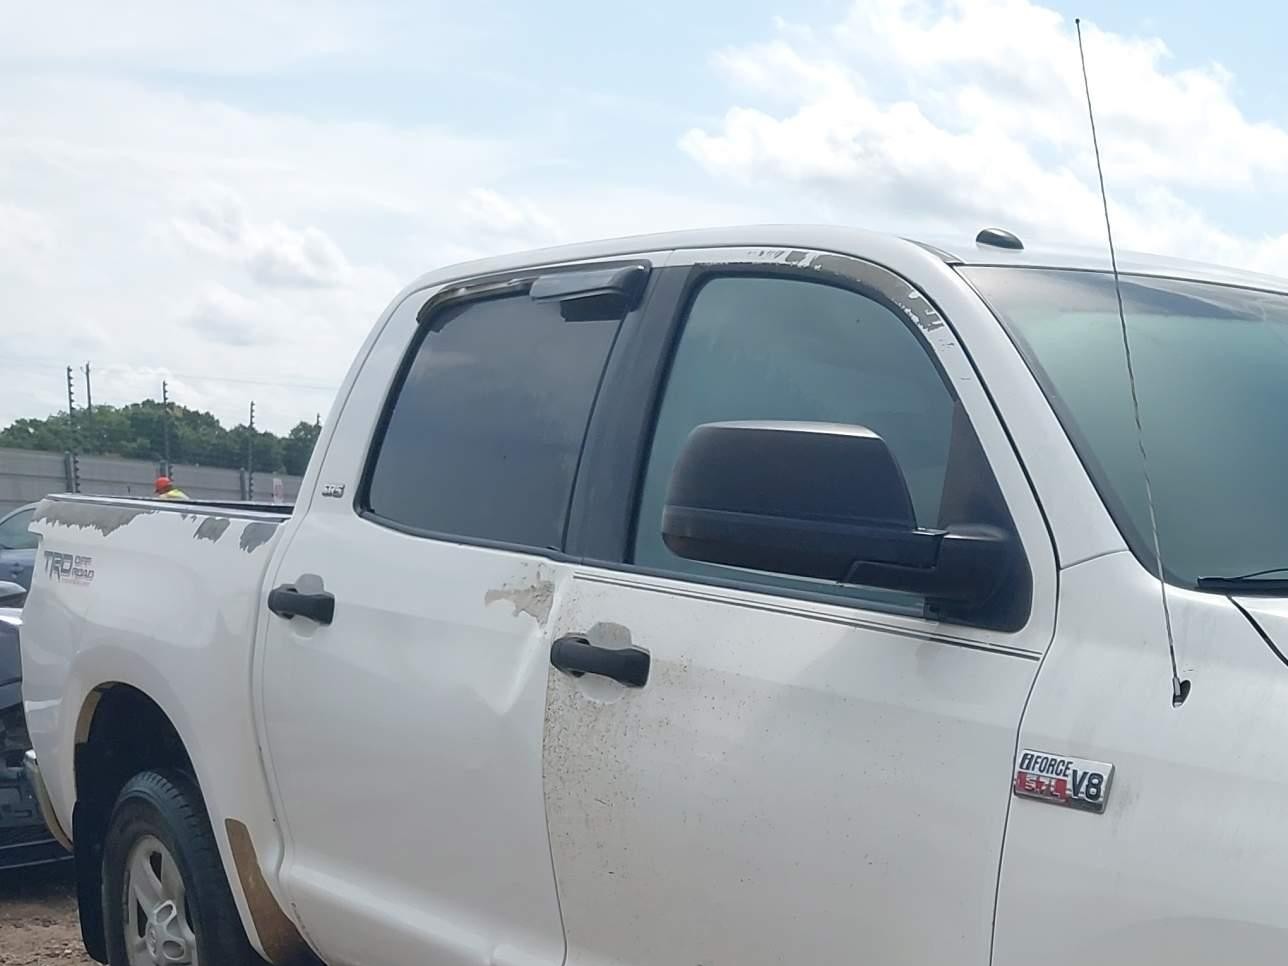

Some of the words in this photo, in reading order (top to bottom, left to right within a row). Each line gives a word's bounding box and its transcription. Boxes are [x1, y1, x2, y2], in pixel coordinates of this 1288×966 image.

[44, 550, 74, 582] TRD
[72, 567, 95, 579] ROAD
[1071, 768, 1104, 802] V8
